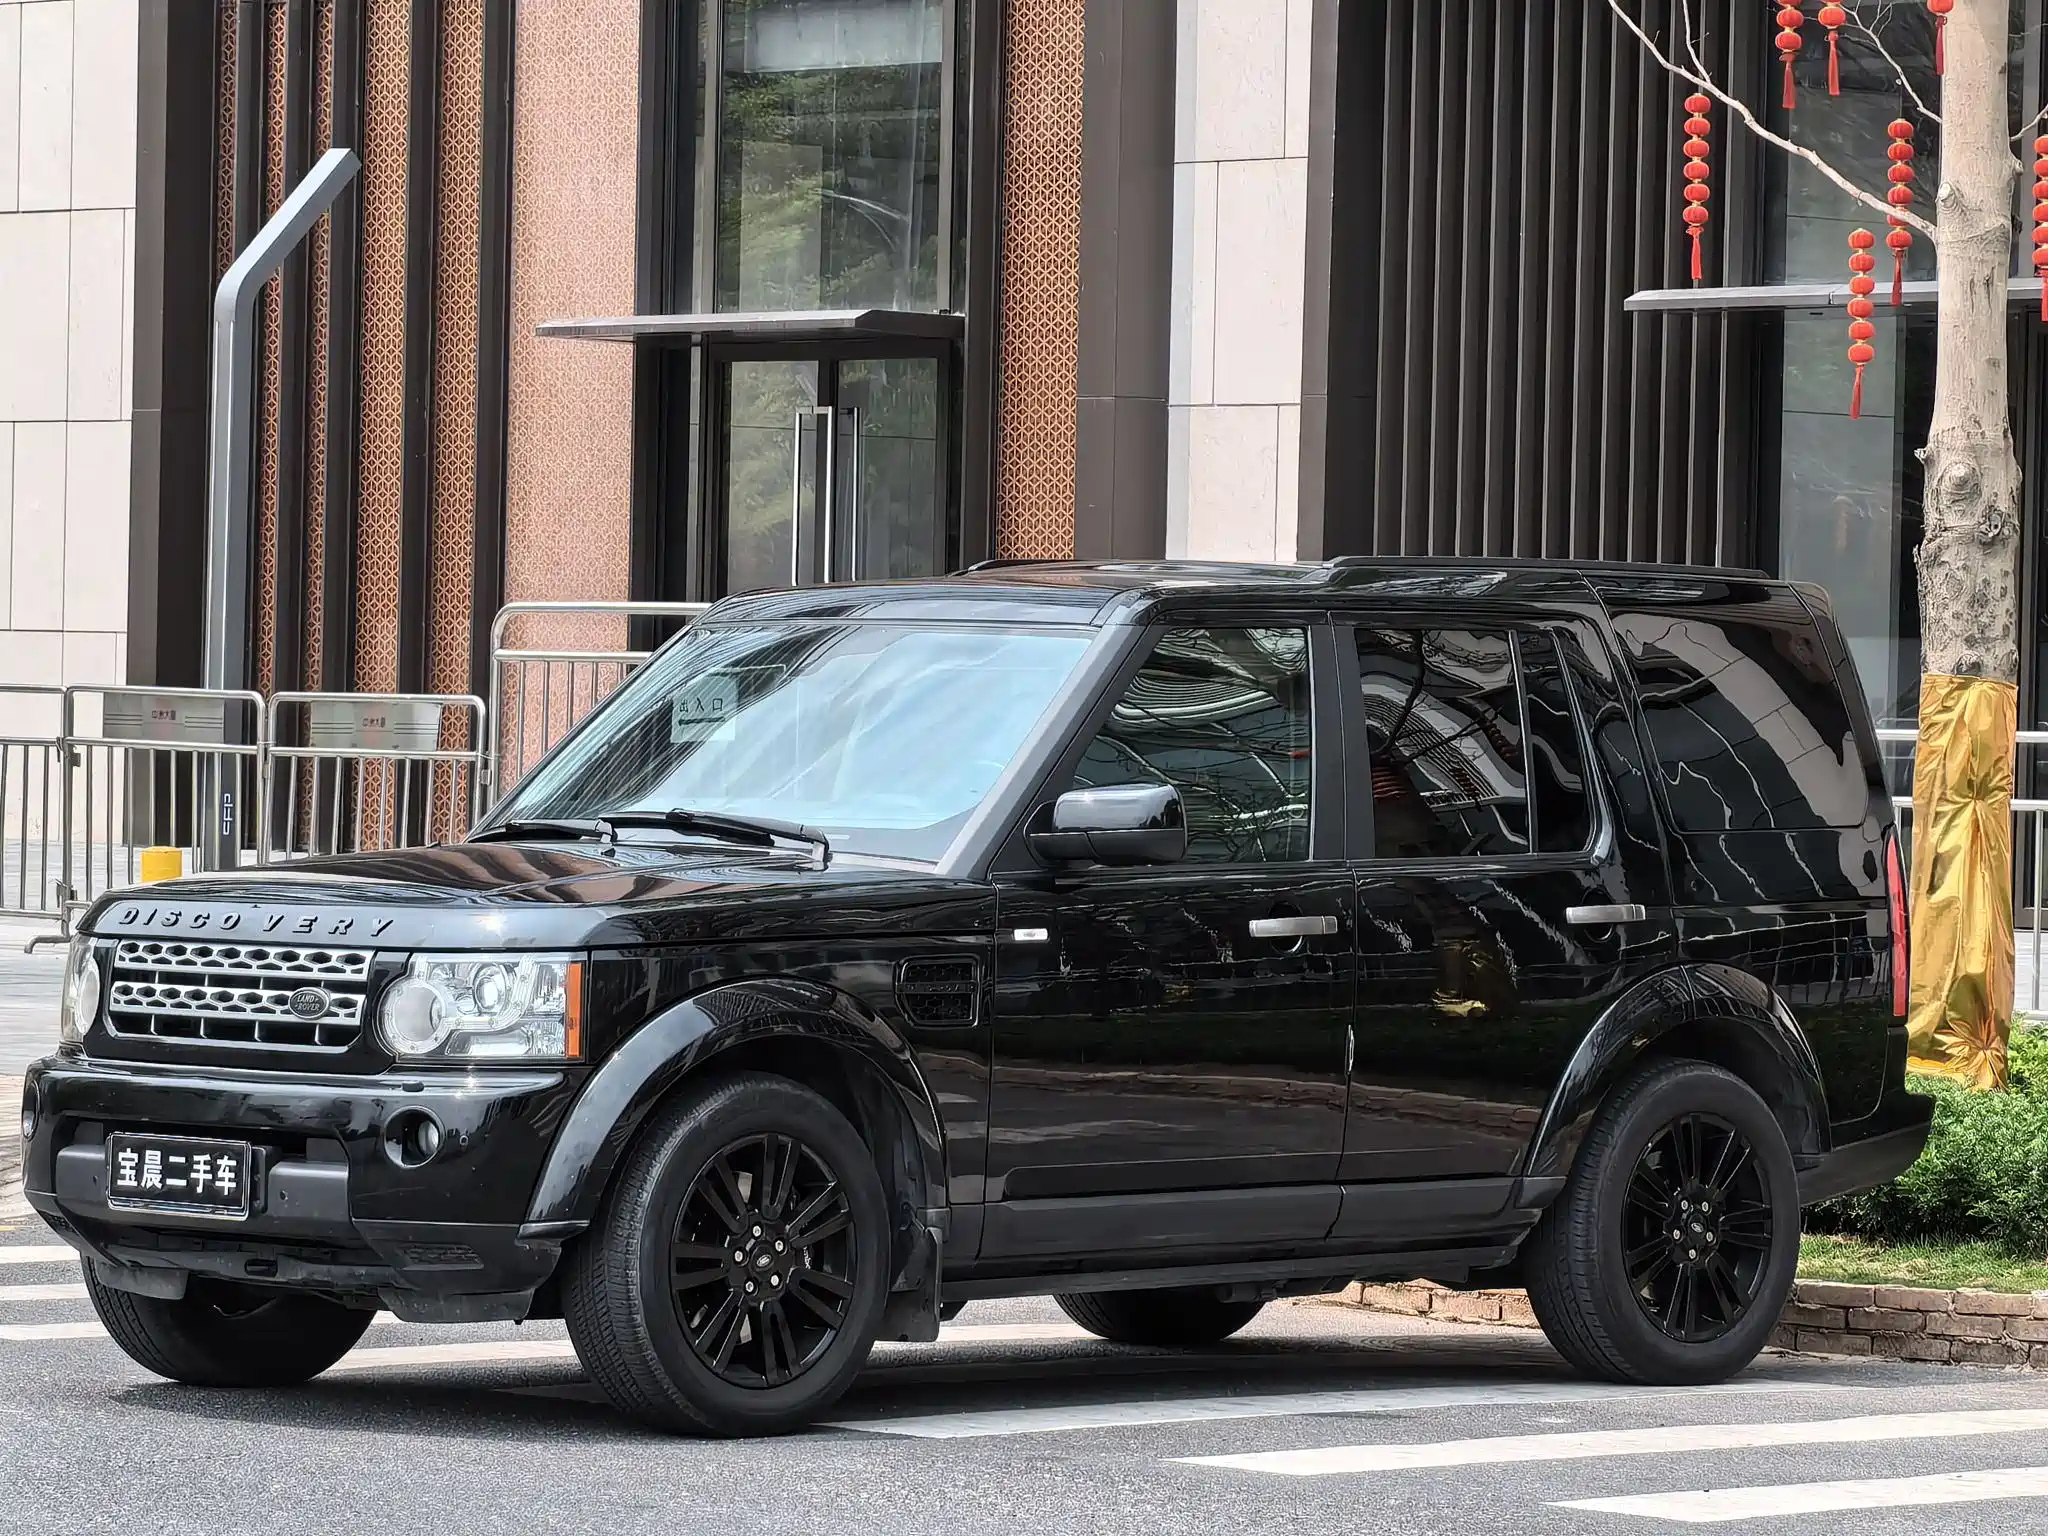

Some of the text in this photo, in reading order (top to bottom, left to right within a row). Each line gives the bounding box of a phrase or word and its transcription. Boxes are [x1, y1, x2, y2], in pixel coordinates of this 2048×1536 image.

[679, 697, 723, 712] 出入口
[118, 906, 394, 937] DISCOVERY
[296, 993, 315, 1003] LAND
[297, 1002, 320, 1011] ROVER
[116, 1147, 237, 1196] 宝晨二手车
